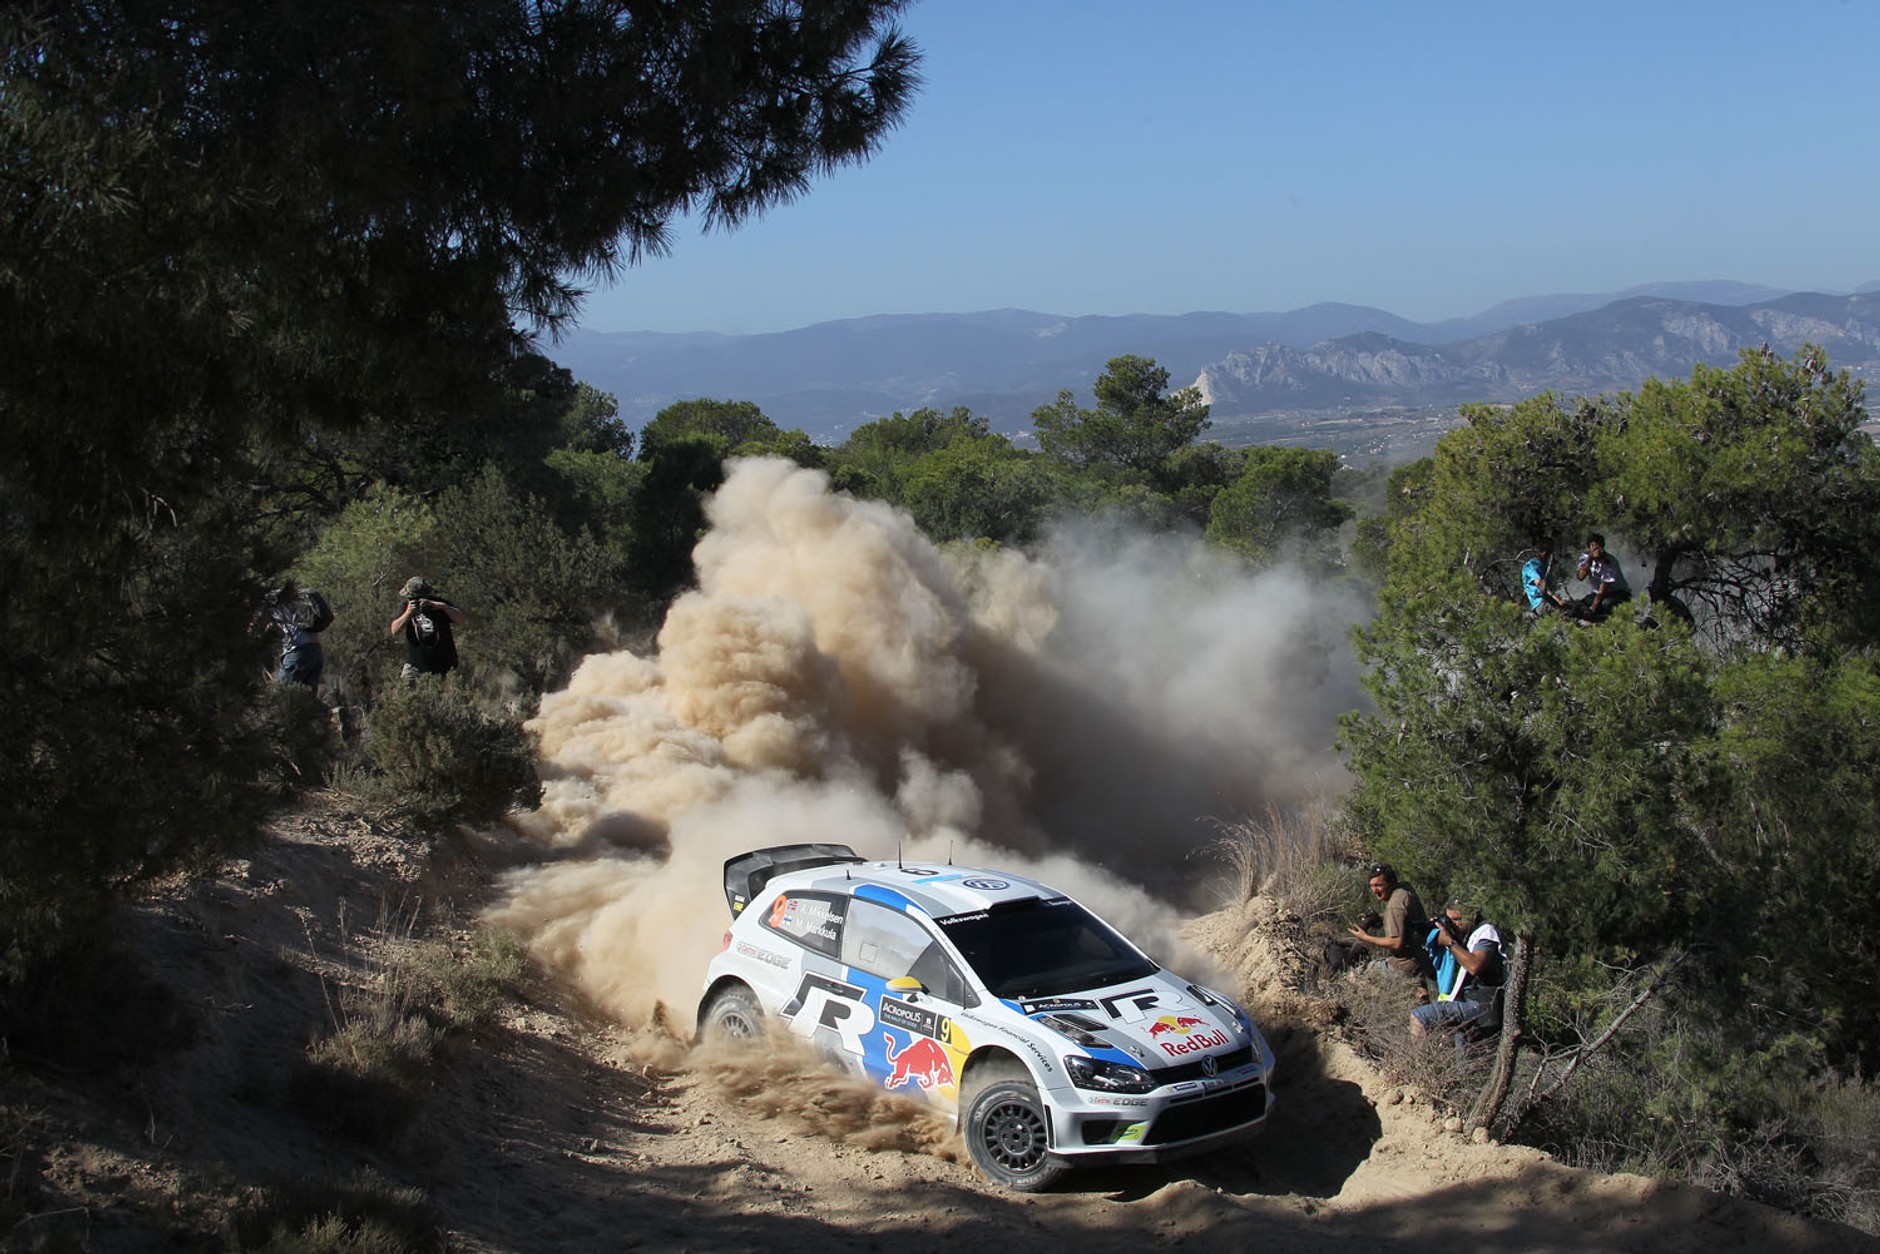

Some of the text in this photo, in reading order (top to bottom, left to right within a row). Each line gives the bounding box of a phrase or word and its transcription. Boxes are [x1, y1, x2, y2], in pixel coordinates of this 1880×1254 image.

[940, 913, 990, 926] Volkswagen
[757, 949, 792, 970] EDGE
[882, 1002, 922, 1023] ACROPOLIS
[941, 1017, 950, 1043] 9
[961, 1012, 1054, 1073] Volkswagen Financial Services
[1113, 1097, 1150, 1107] EDGE
